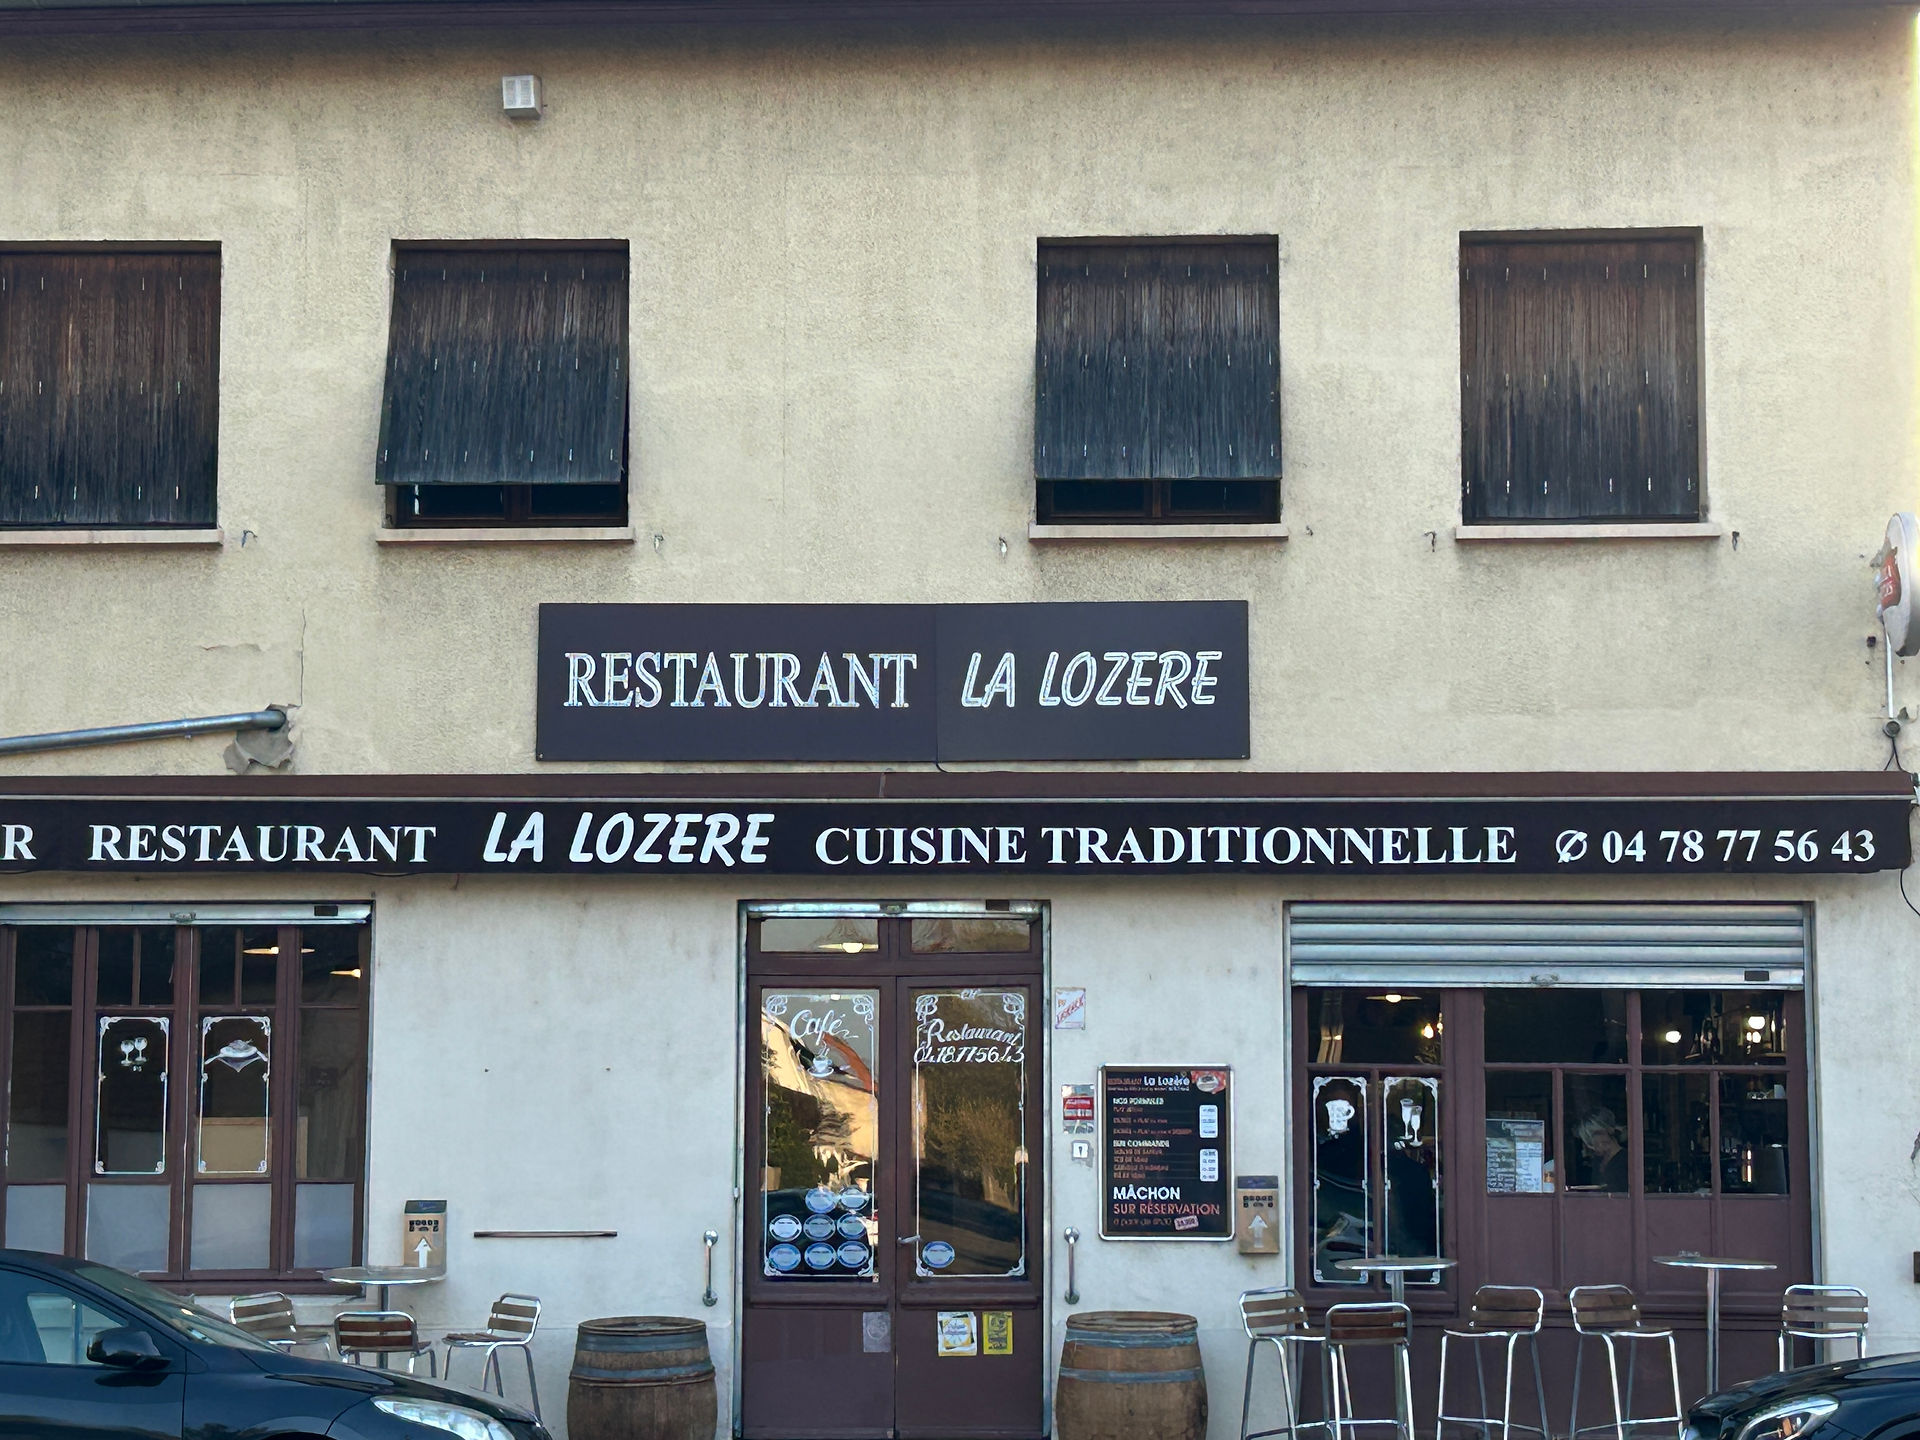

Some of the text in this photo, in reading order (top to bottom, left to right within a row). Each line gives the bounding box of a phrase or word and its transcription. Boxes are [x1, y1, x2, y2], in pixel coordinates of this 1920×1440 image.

[563, 650, 1223, 710] RESTAURANT LA LOZERE
[87, 824, 437, 863] RESTAURANT
[482, 811, 544, 863] LA
[568, 811, 775, 867] LOZERE
[815, 826, 1027, 865] CUISINE
[1040, 826, 1518, 865] TRADITIONNELLE
[1602, 829, 1647, 864] 04
[1658, 829, 1705, 863] 78
[1716, 829, 1761, 862] 77
[1774, 829, 1819, 863] 56
[1830, 829, 1876, 862] 43
[789, 1008, 856, 1046] Café
[923, 1018, 1024, 1050] Restaurant
[1113, 1184, 1181, 1200] MÂCHON
[1113, 1200, 1221, 1216] SUR RÉSERVATION
